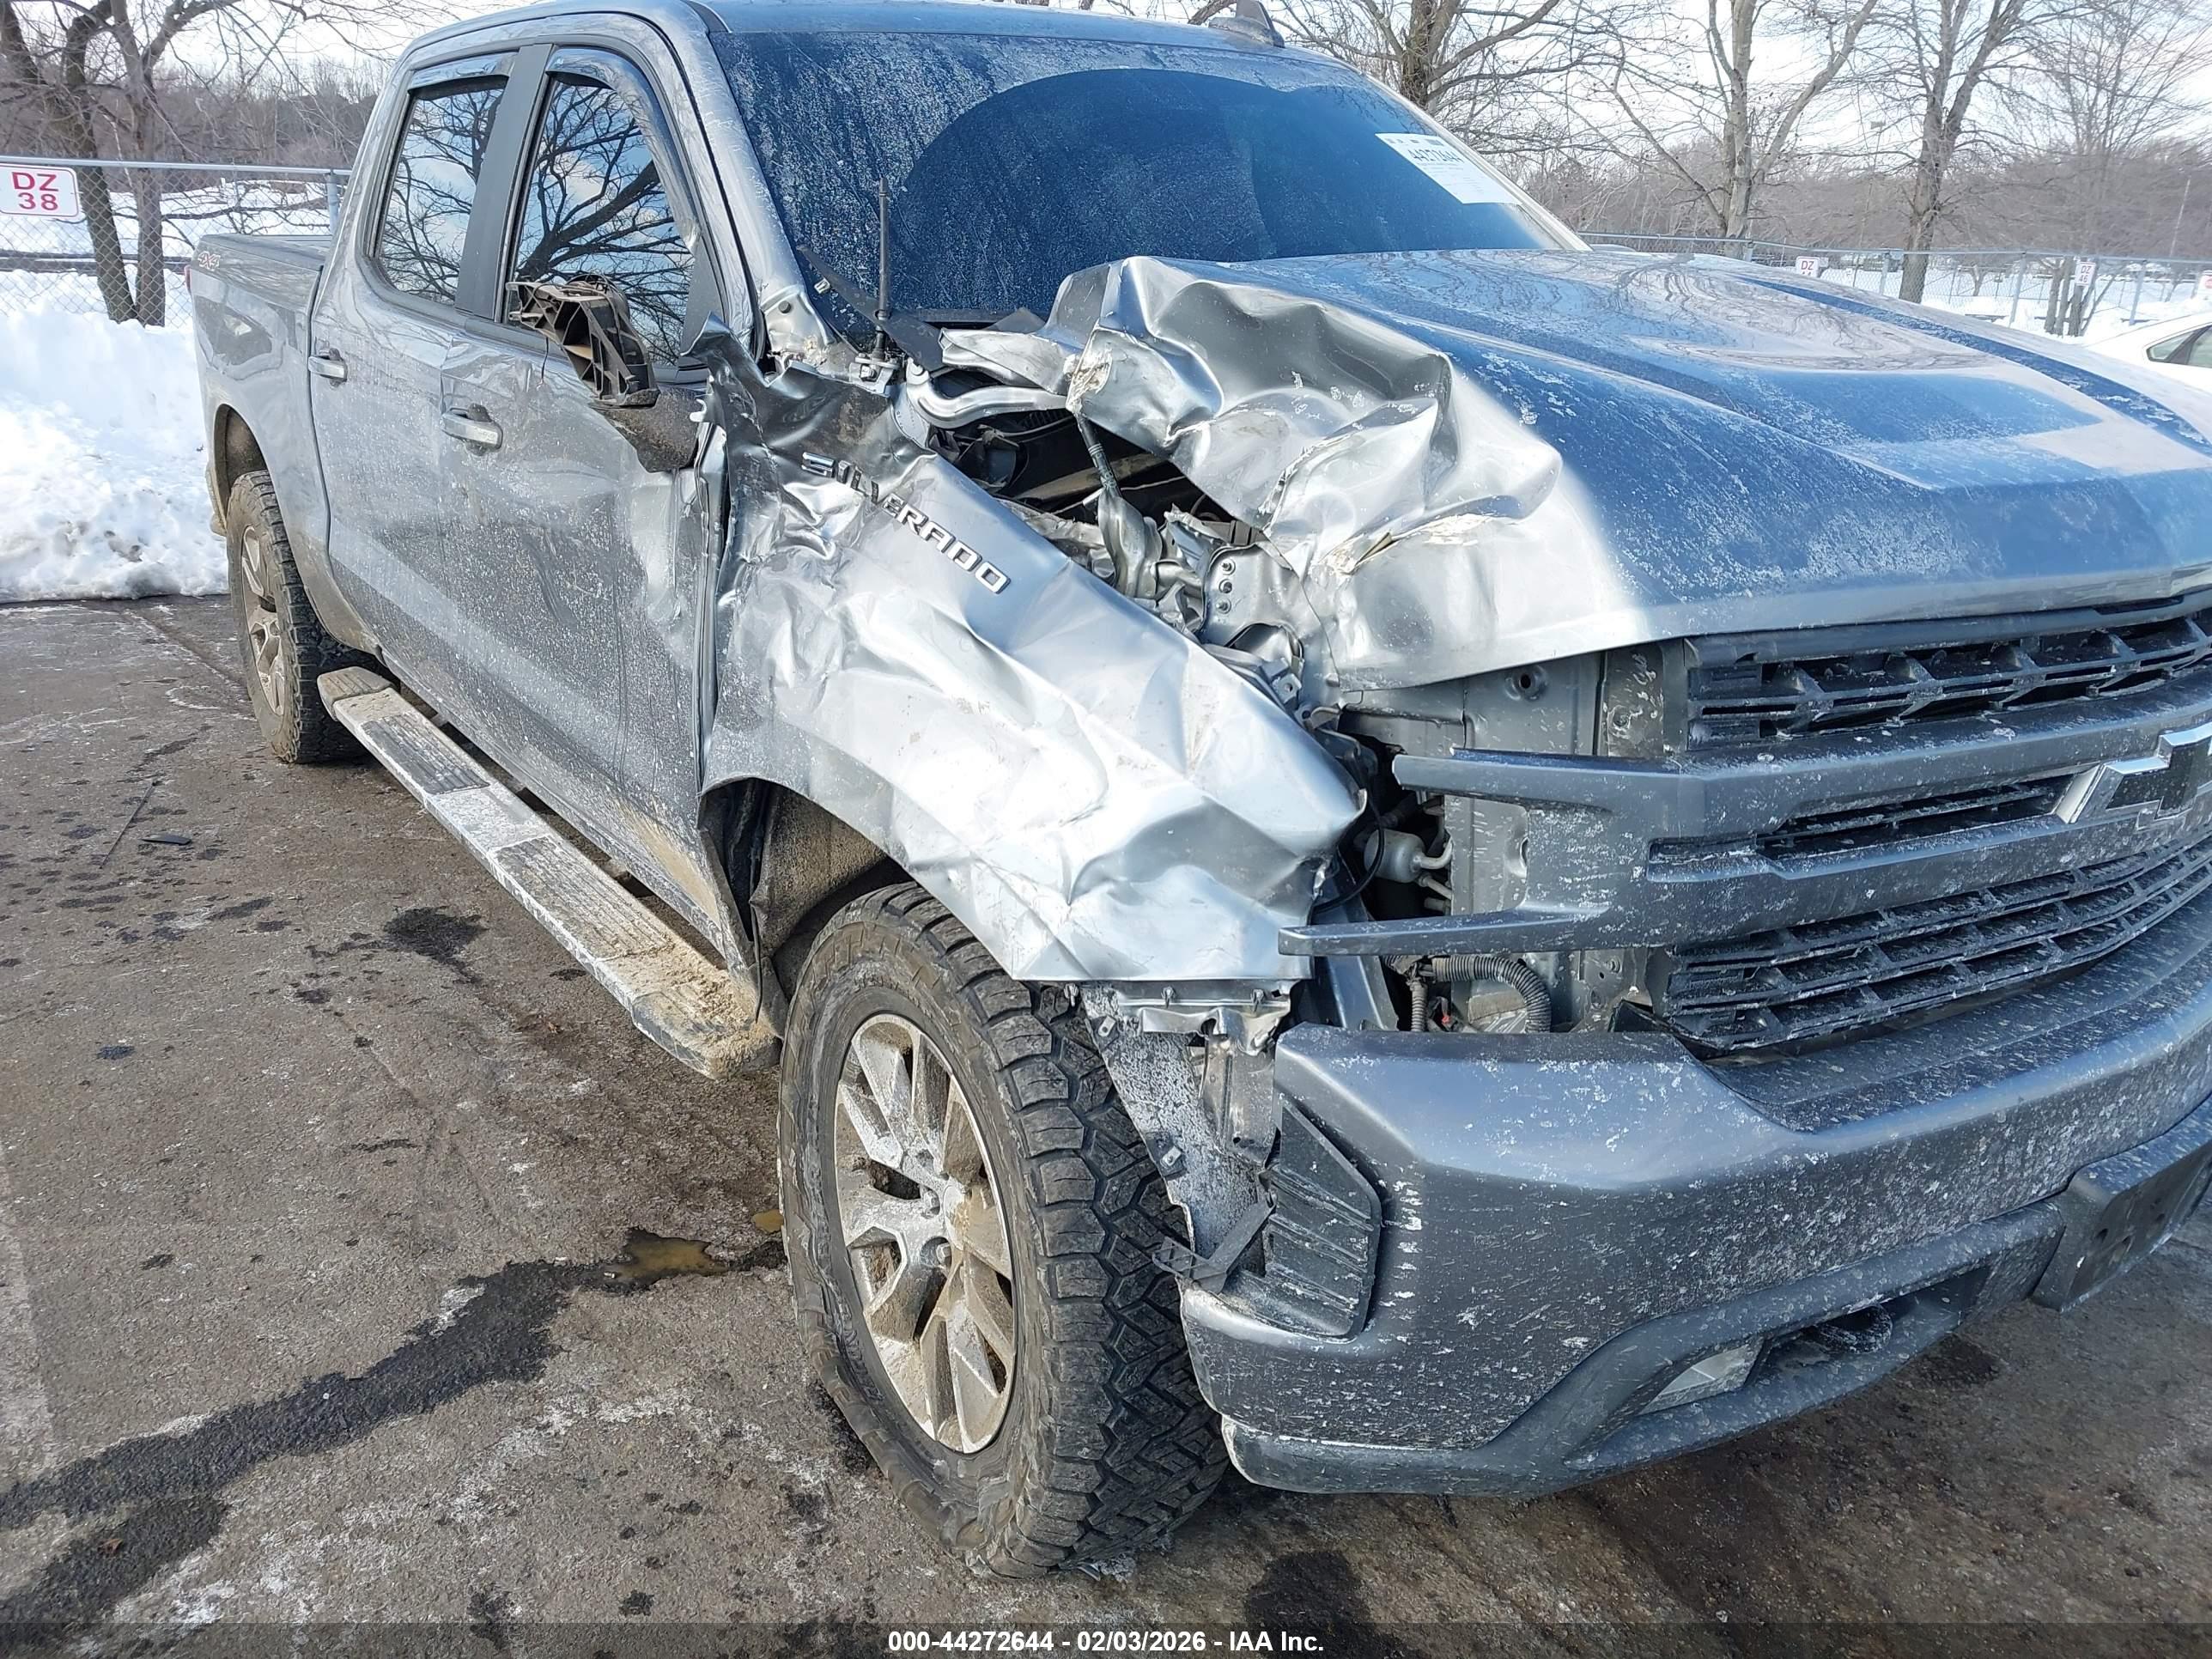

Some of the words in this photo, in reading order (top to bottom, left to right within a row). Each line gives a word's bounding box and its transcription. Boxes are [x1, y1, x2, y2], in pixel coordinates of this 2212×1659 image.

[11, 171, 59, 191] DZ
[17, 191, 58, 211] 38
[1801, 260, 1814, 270] DZ
[2080, 264, 2092, 274] DZ
